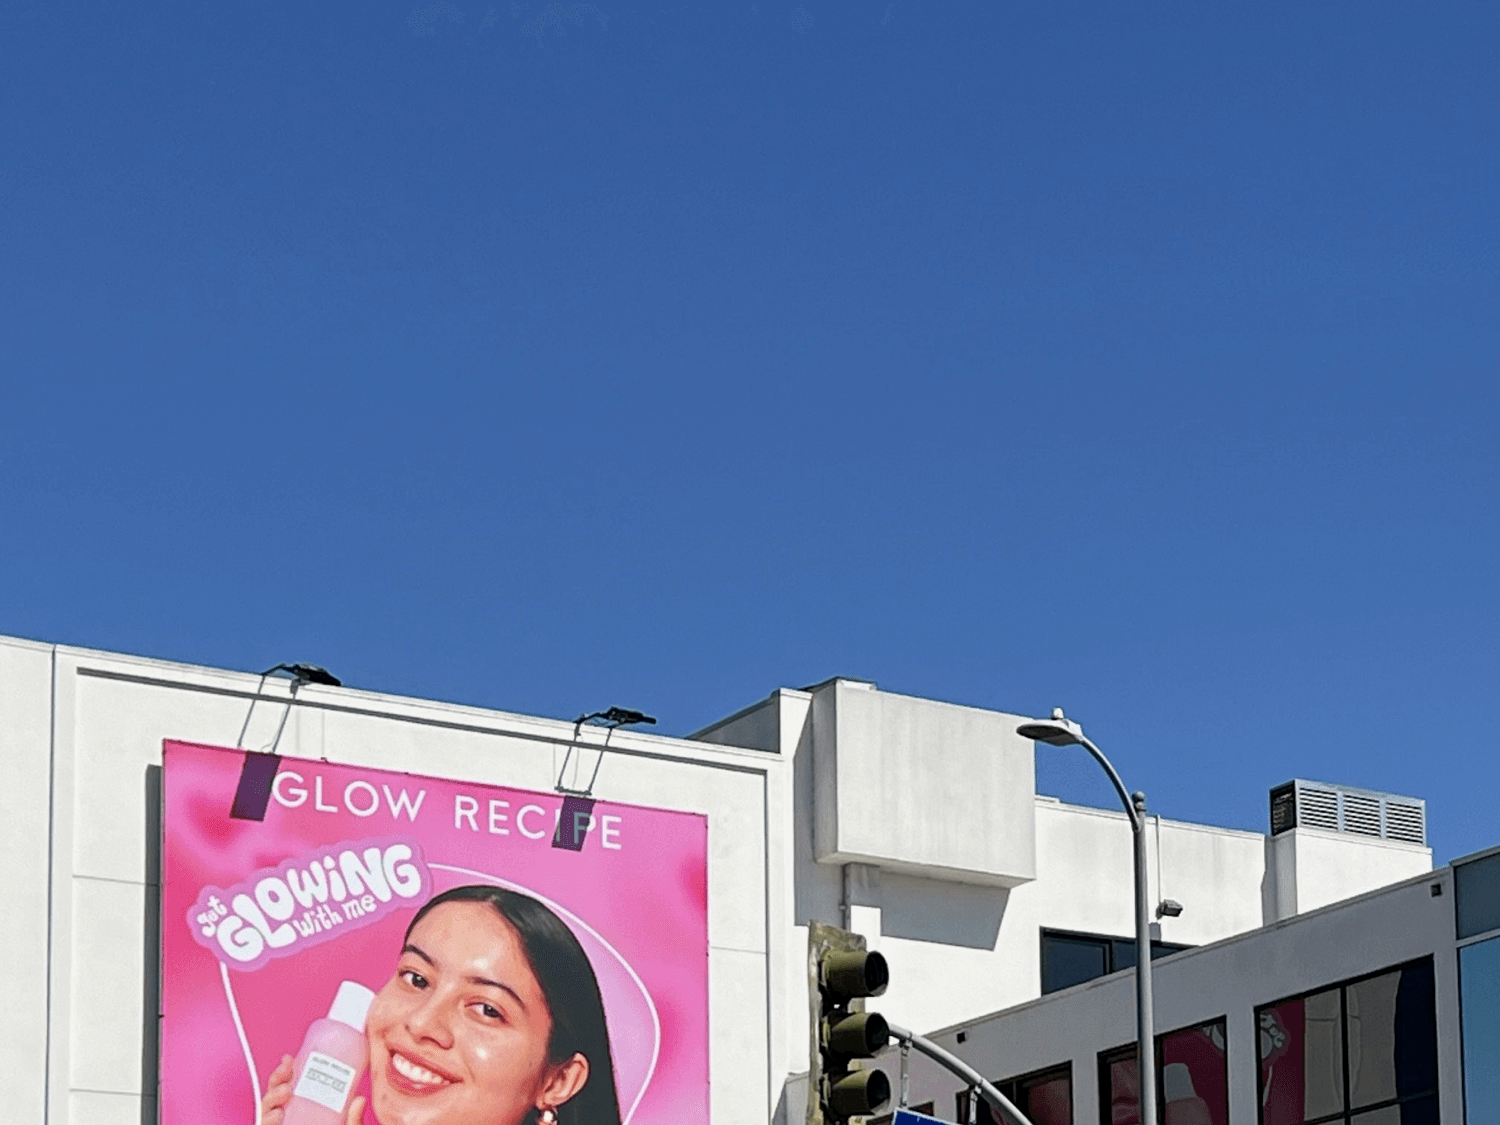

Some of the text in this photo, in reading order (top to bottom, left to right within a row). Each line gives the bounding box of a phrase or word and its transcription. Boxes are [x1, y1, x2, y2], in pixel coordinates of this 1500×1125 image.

[272, 771, 622, 850] GLOW RECIPE
[197, 894, 228, 938] get
[293, 894, 377, 938] with me
